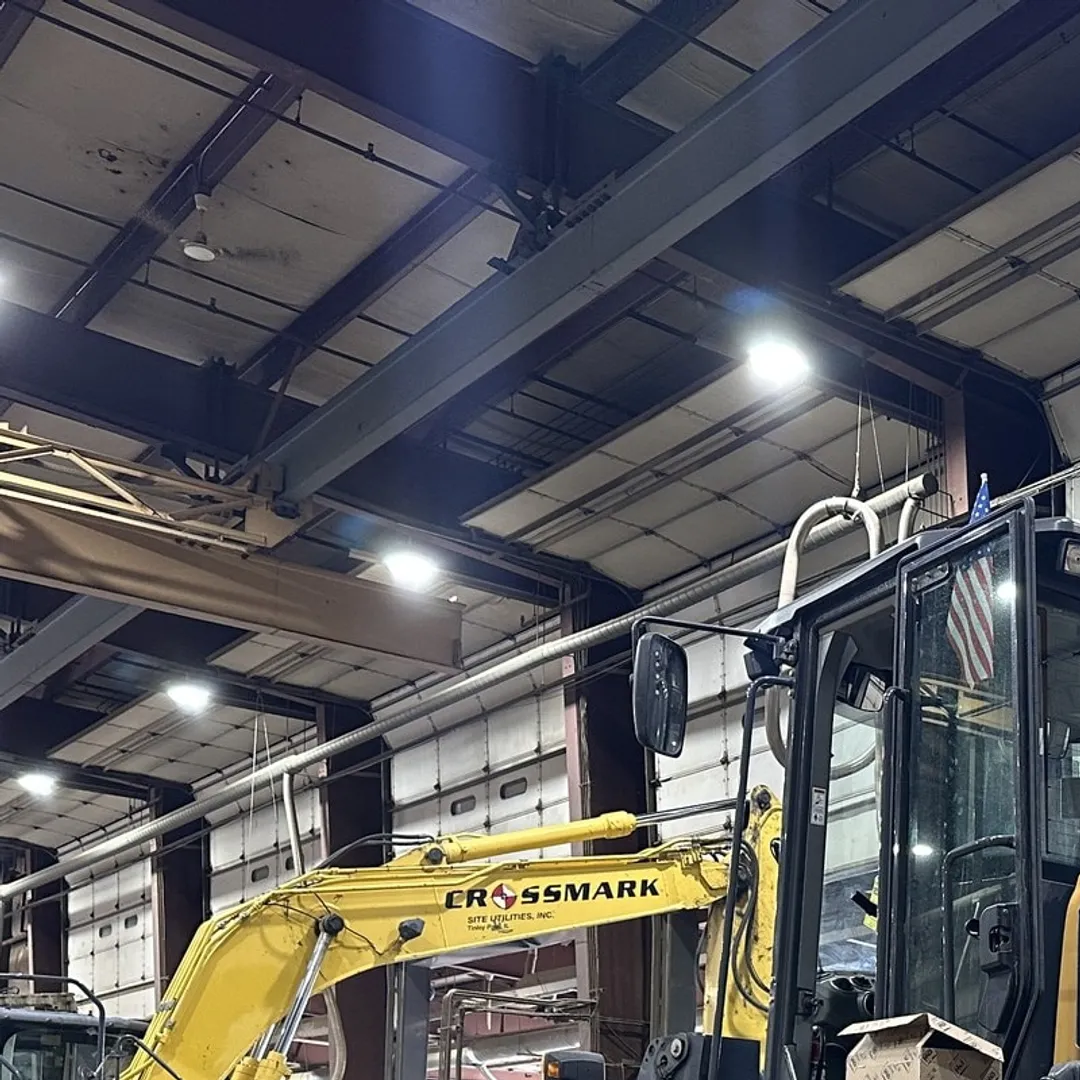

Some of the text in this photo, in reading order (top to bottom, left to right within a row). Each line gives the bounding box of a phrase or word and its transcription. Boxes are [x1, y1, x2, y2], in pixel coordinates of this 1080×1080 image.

[444, 878, 660, 910] CROSSMARK
[467, 915, 488, 924] SITE
[536, 911, 555, 920] INC.
